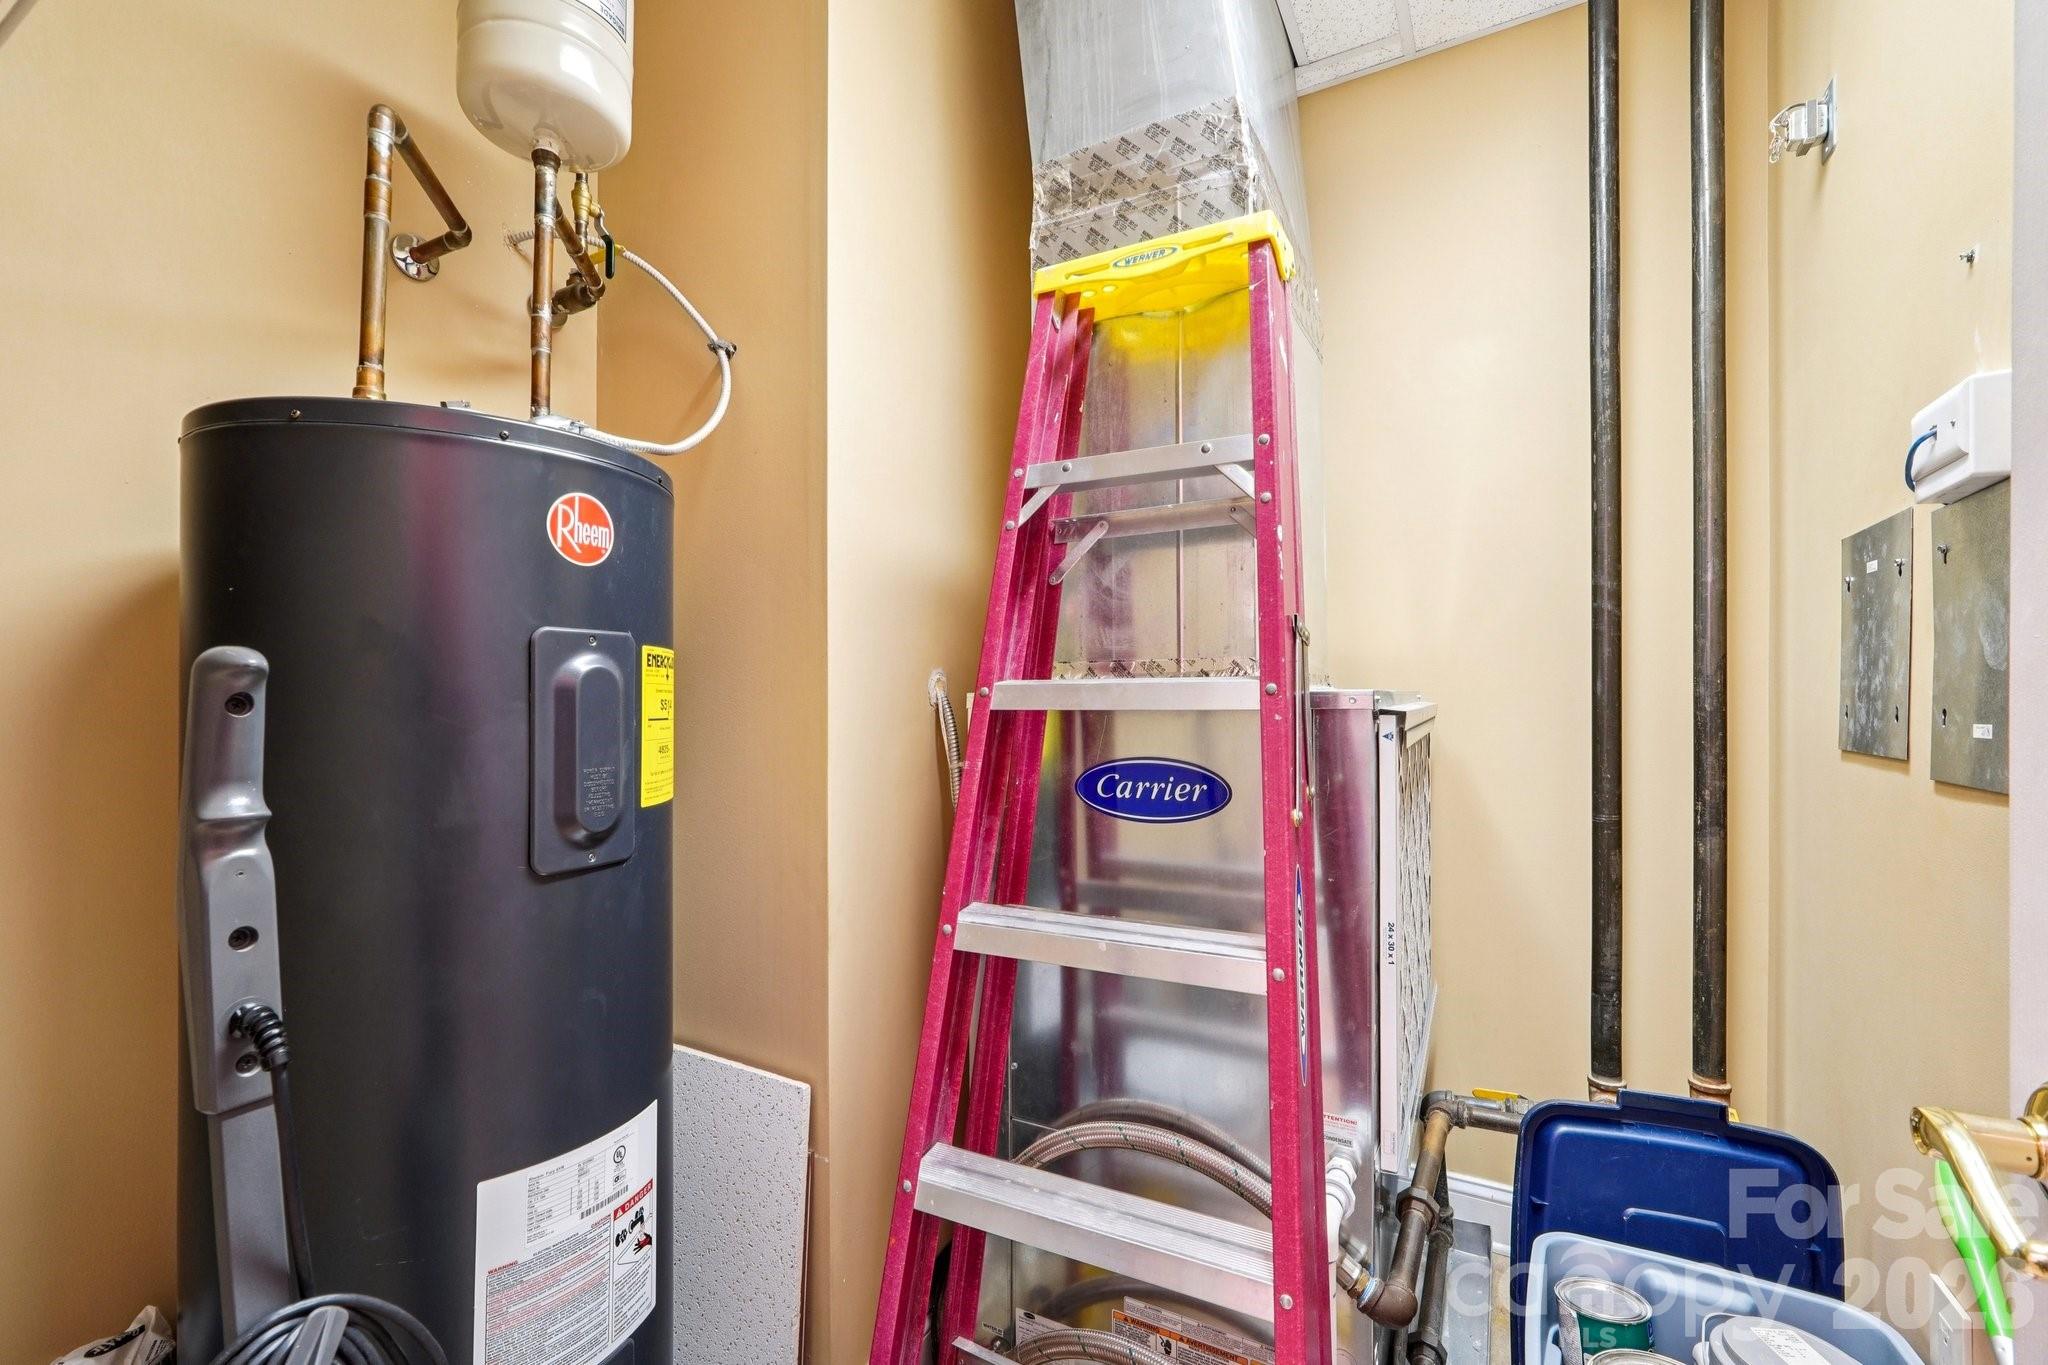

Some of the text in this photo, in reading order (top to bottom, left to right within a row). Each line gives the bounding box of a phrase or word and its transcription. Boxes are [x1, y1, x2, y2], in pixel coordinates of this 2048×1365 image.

[1124, 249, 1166, 265] WERNER
[557, 496, 609, 554] Rheem
[1097, 773, 1208, 802] Carrier
[1387, 922, 1395, 933] 24
[1387, 941, 1395, 952] 30
[624, 1184, 652, 1211] DANGER
